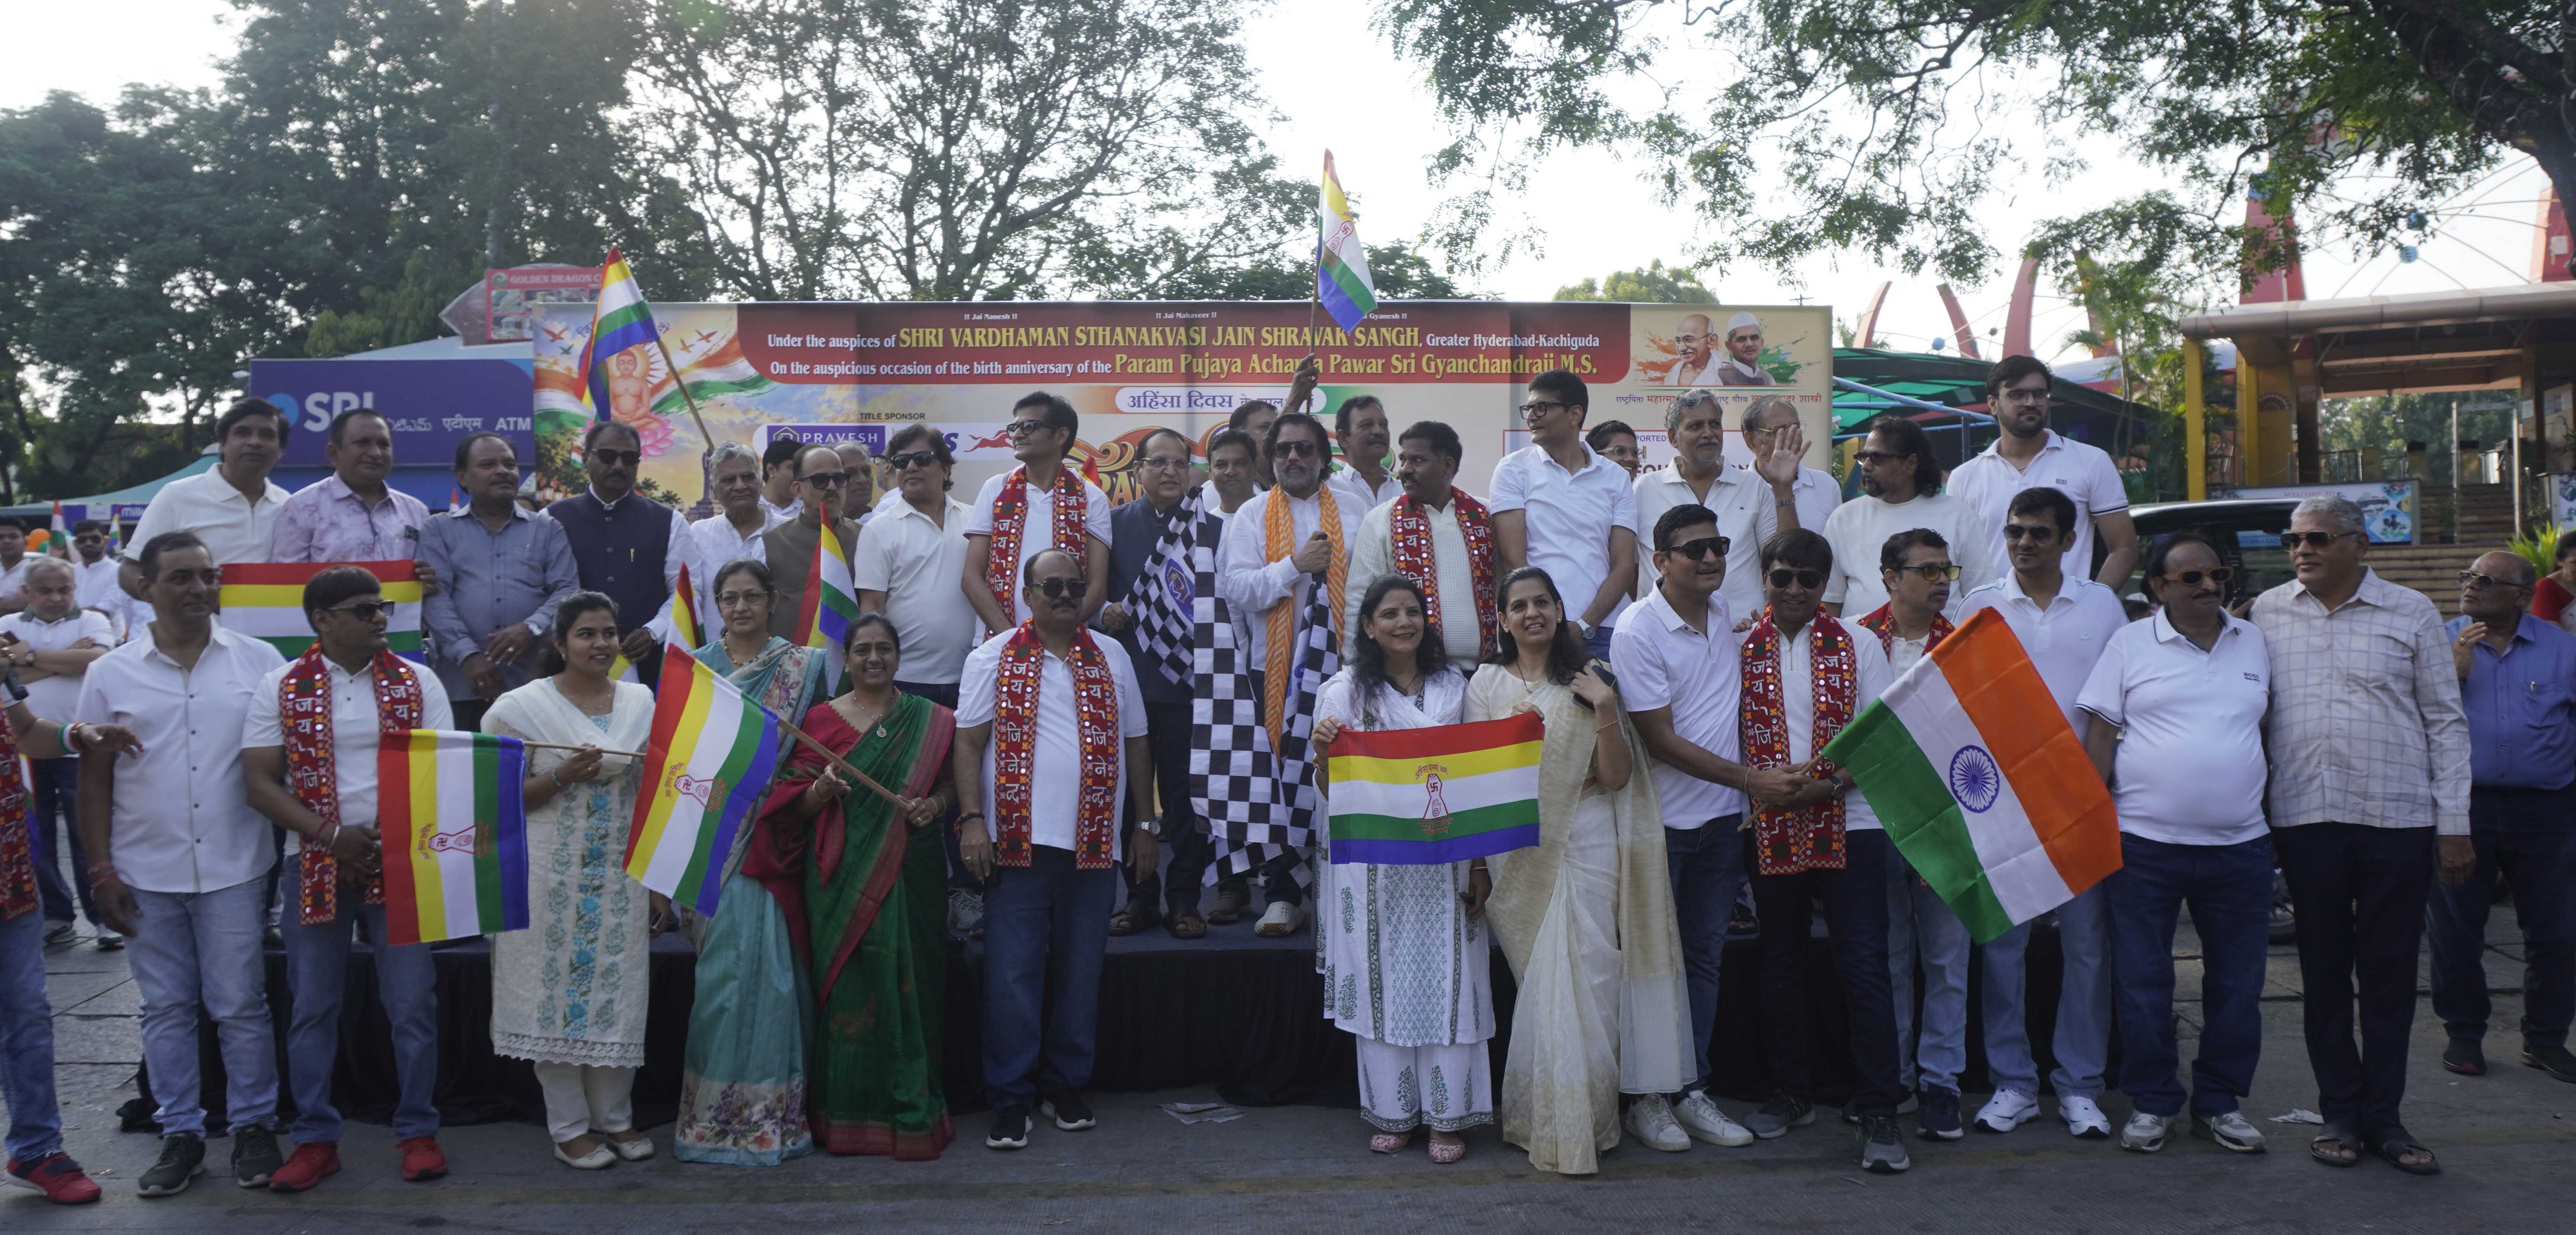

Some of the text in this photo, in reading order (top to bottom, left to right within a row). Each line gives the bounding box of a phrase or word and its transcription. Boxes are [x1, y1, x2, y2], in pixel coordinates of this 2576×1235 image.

[510, 275, 549, 284] GOLDEN
[767, 326, 1599, 351] Under the auspices of SHRI VARDHAMAN STHANAKVASI JAIN SHRAVAK SANGH, Greater Hyderabad-Kachiguda
[770, 361, 788, 374] On
[791, 361, 810, 374] the
[813, 361, 876, 378] auspicious
[879, 361, 932, 374] occasion
[935, 361, 948, 374] of
[951, 361, 970, 374] the
[973, 361, 1002, 374] birth
[1005, 361, 1074, 377] anniversary
[1077, 360, 1090, 374] of
[1092, 360, 1112, 374] the
[1115, 354, 1175, 374] Param
[1180, 352, 1243, 380] Pujaya
[1248, 353, 1324, 374] Achara
[1329, 354, 1386, 374] Pawar
[1391, 353, 1416, 374] Sri
[1560, 354, 1599, 375] M.S.
[1127, 390, 1182, 410] अहिंसा
[1187, 390, 1233, 408] दिवस
[1616, 394, 1643, 405] राष्ट्रपिता
[1732, 394, 1748, 403] गौरव
[1799, 392, 1822, 403] शास्त्री
[442, 413, 483, 431] एटीएम
[495, 417, 532, 431] ATM
[802, 432, 878, 443] PRAVESH
